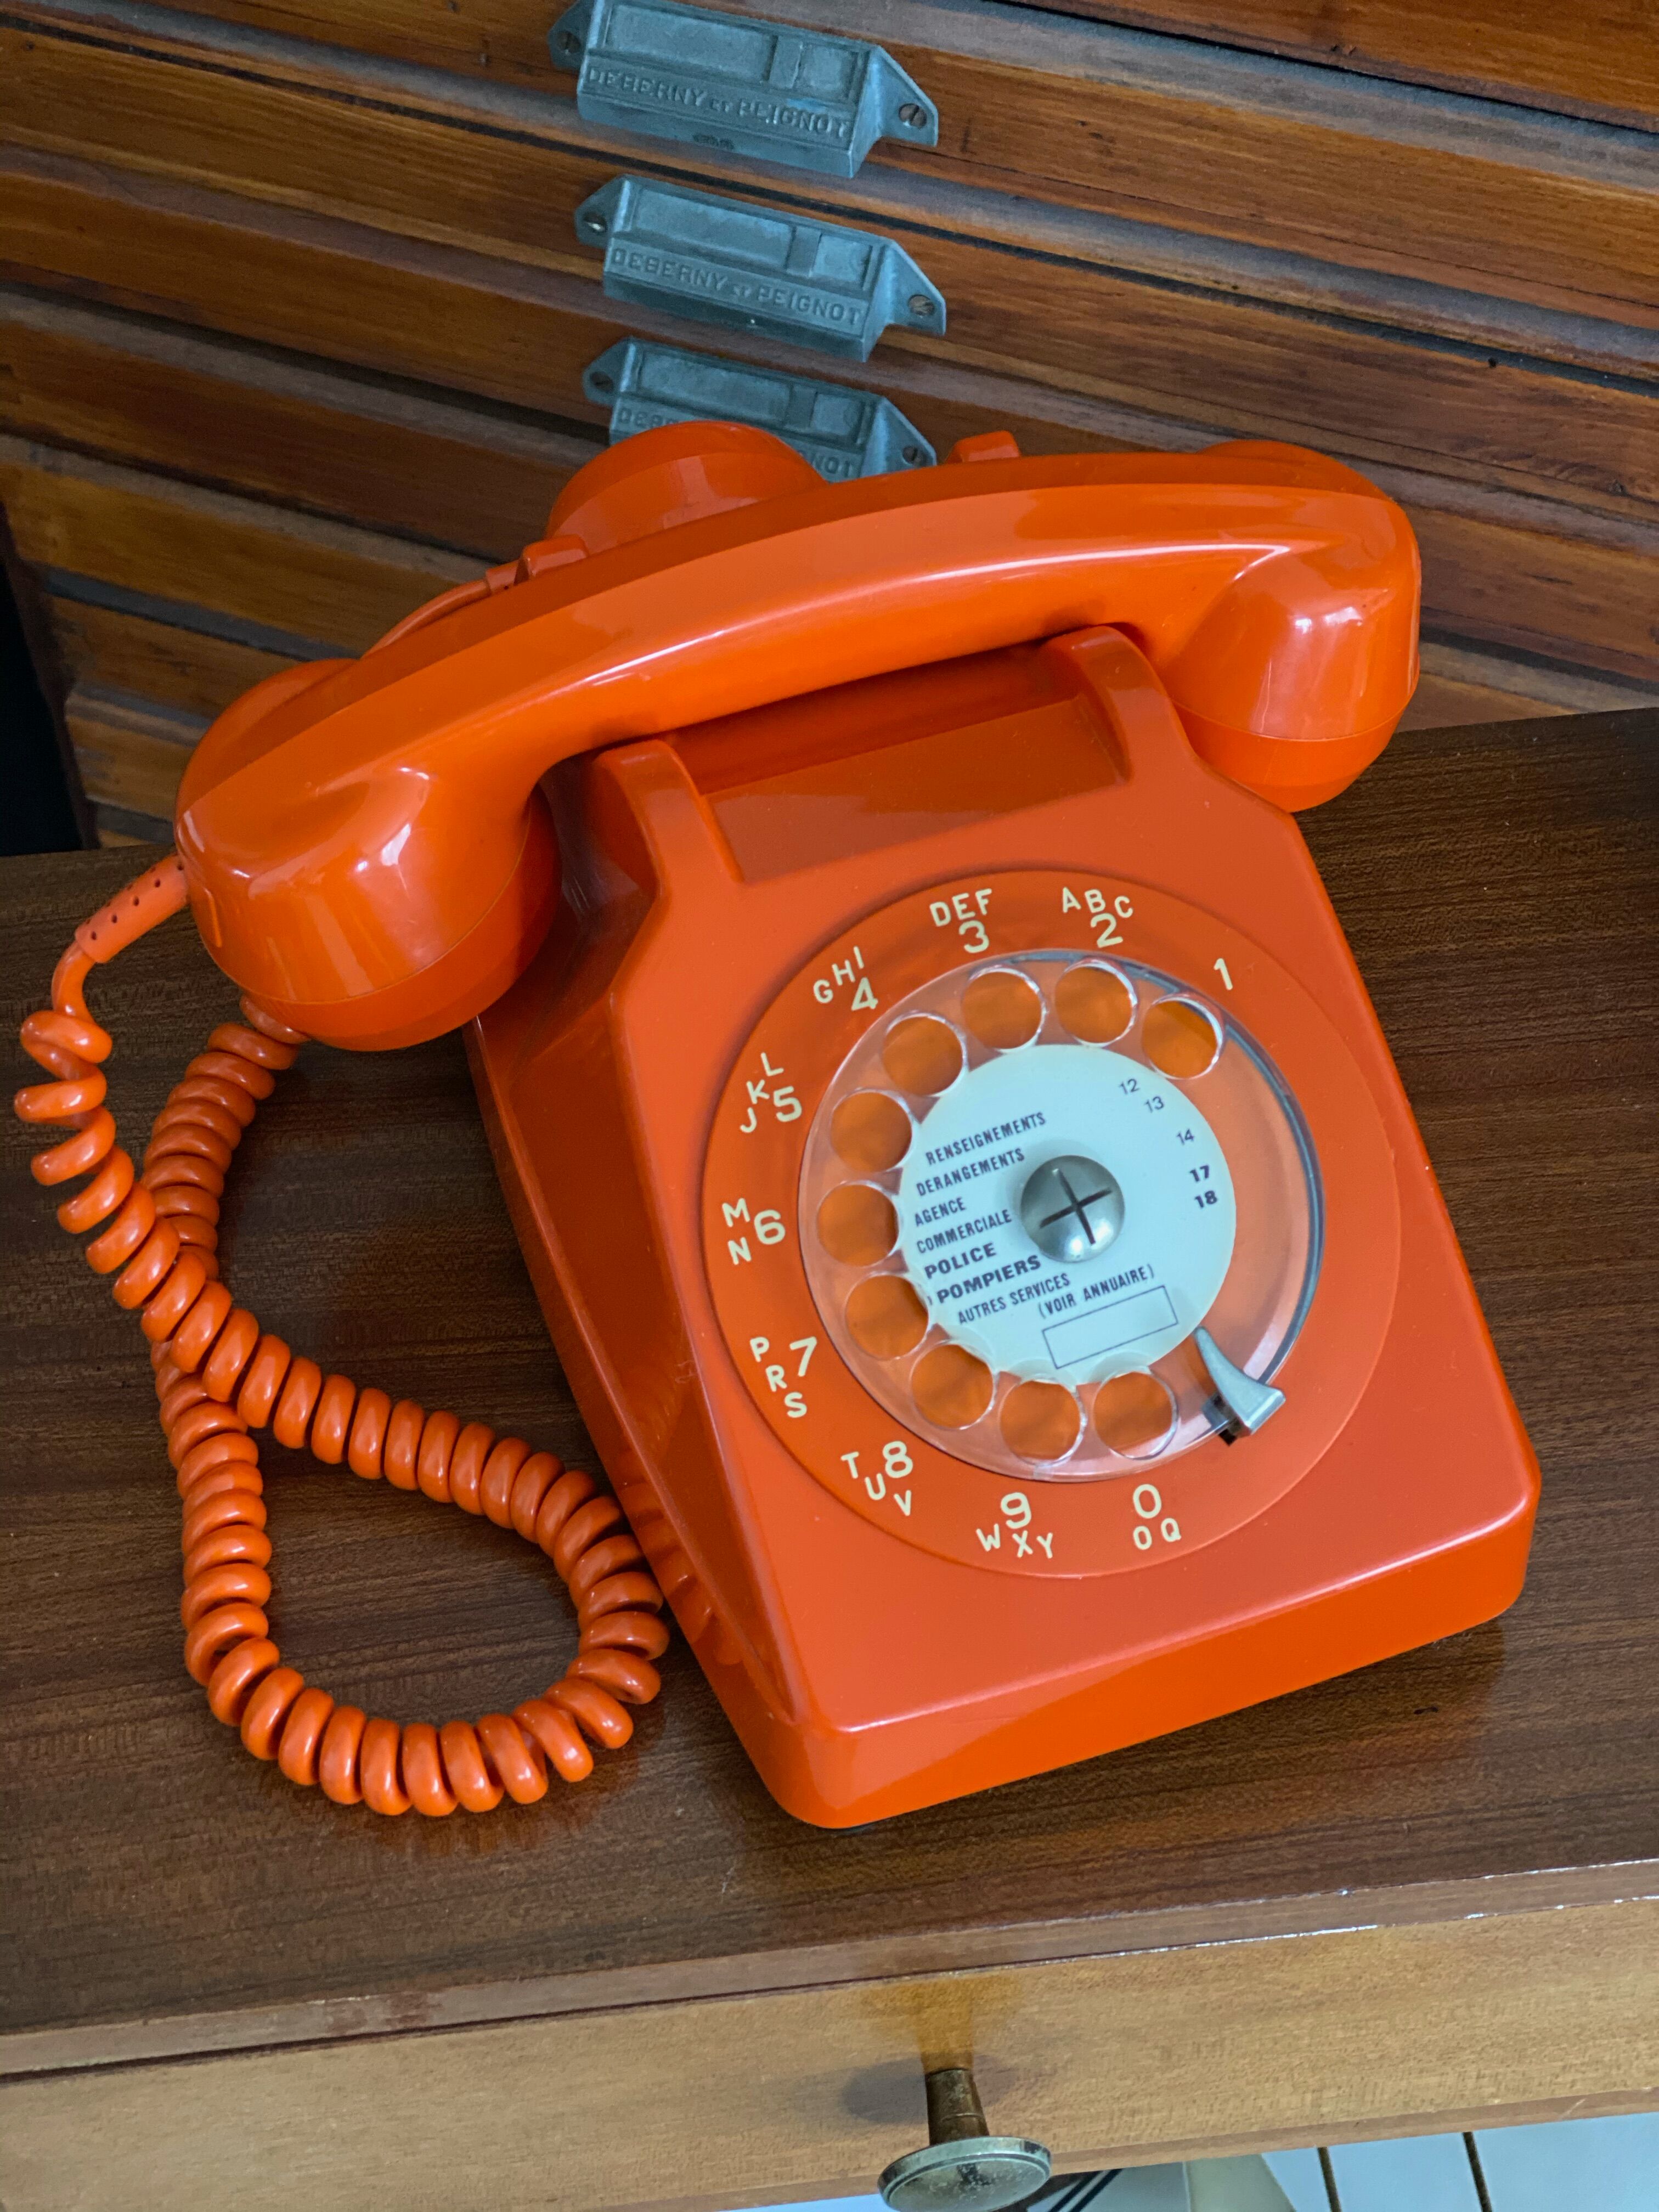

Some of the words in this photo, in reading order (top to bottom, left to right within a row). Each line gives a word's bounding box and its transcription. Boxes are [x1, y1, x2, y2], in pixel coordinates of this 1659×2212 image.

[611, 248, 729, 291] DEBERNY
[755, 284, 865, 326] PEIGNOT
[929, 888, 992, 927] DEF
[1062, 886, 1134, 919] ABC
[958, 919, 990, 954] 3
[1090, 912, 1124, 945] 2
[1213, 957, 1234, 991] 1
[850, 977, 879, 1012] 4
[772, 1085, 803, 1123] 5
[1120, 1078, 1139, 1094] 12
[1145, 1096, 1165, 1112] 13
[925, 1112, 1046, 1165] RENSEIGNEMENTS
[1176, 1128, 1194, 1144] 14
[916, 1148, 1025, 1197] DERANGEMENTS
[1189, 1164, 1210, 1183] 17
[915, 1197, 966, 1227] AGENCE
[1194, 1190, 1218, 1209] 18
[753, 1209, 786, 1245] 6
[917, 1209, 1013, 1254] COMMERCIALE
[924, 1242, 997, 1279] POLICE
[936, 1255, 1041, 1304] POMPIERS
[1039, 1293, 1076, 1317] (VOIR
[1083, 1264, 1154, 1301] ANNUAIRE)
[958, 1296, 1006, 1324] AUTRES
[1009, 1273, 1070, 1305] SERVICES
[789, 1336, 818, 1378] 7
[882, 1440, 914, 1479] 8
[1000, 1491, 1032, 1530] 9
[1132, 1483, 1163, 1520] 0
